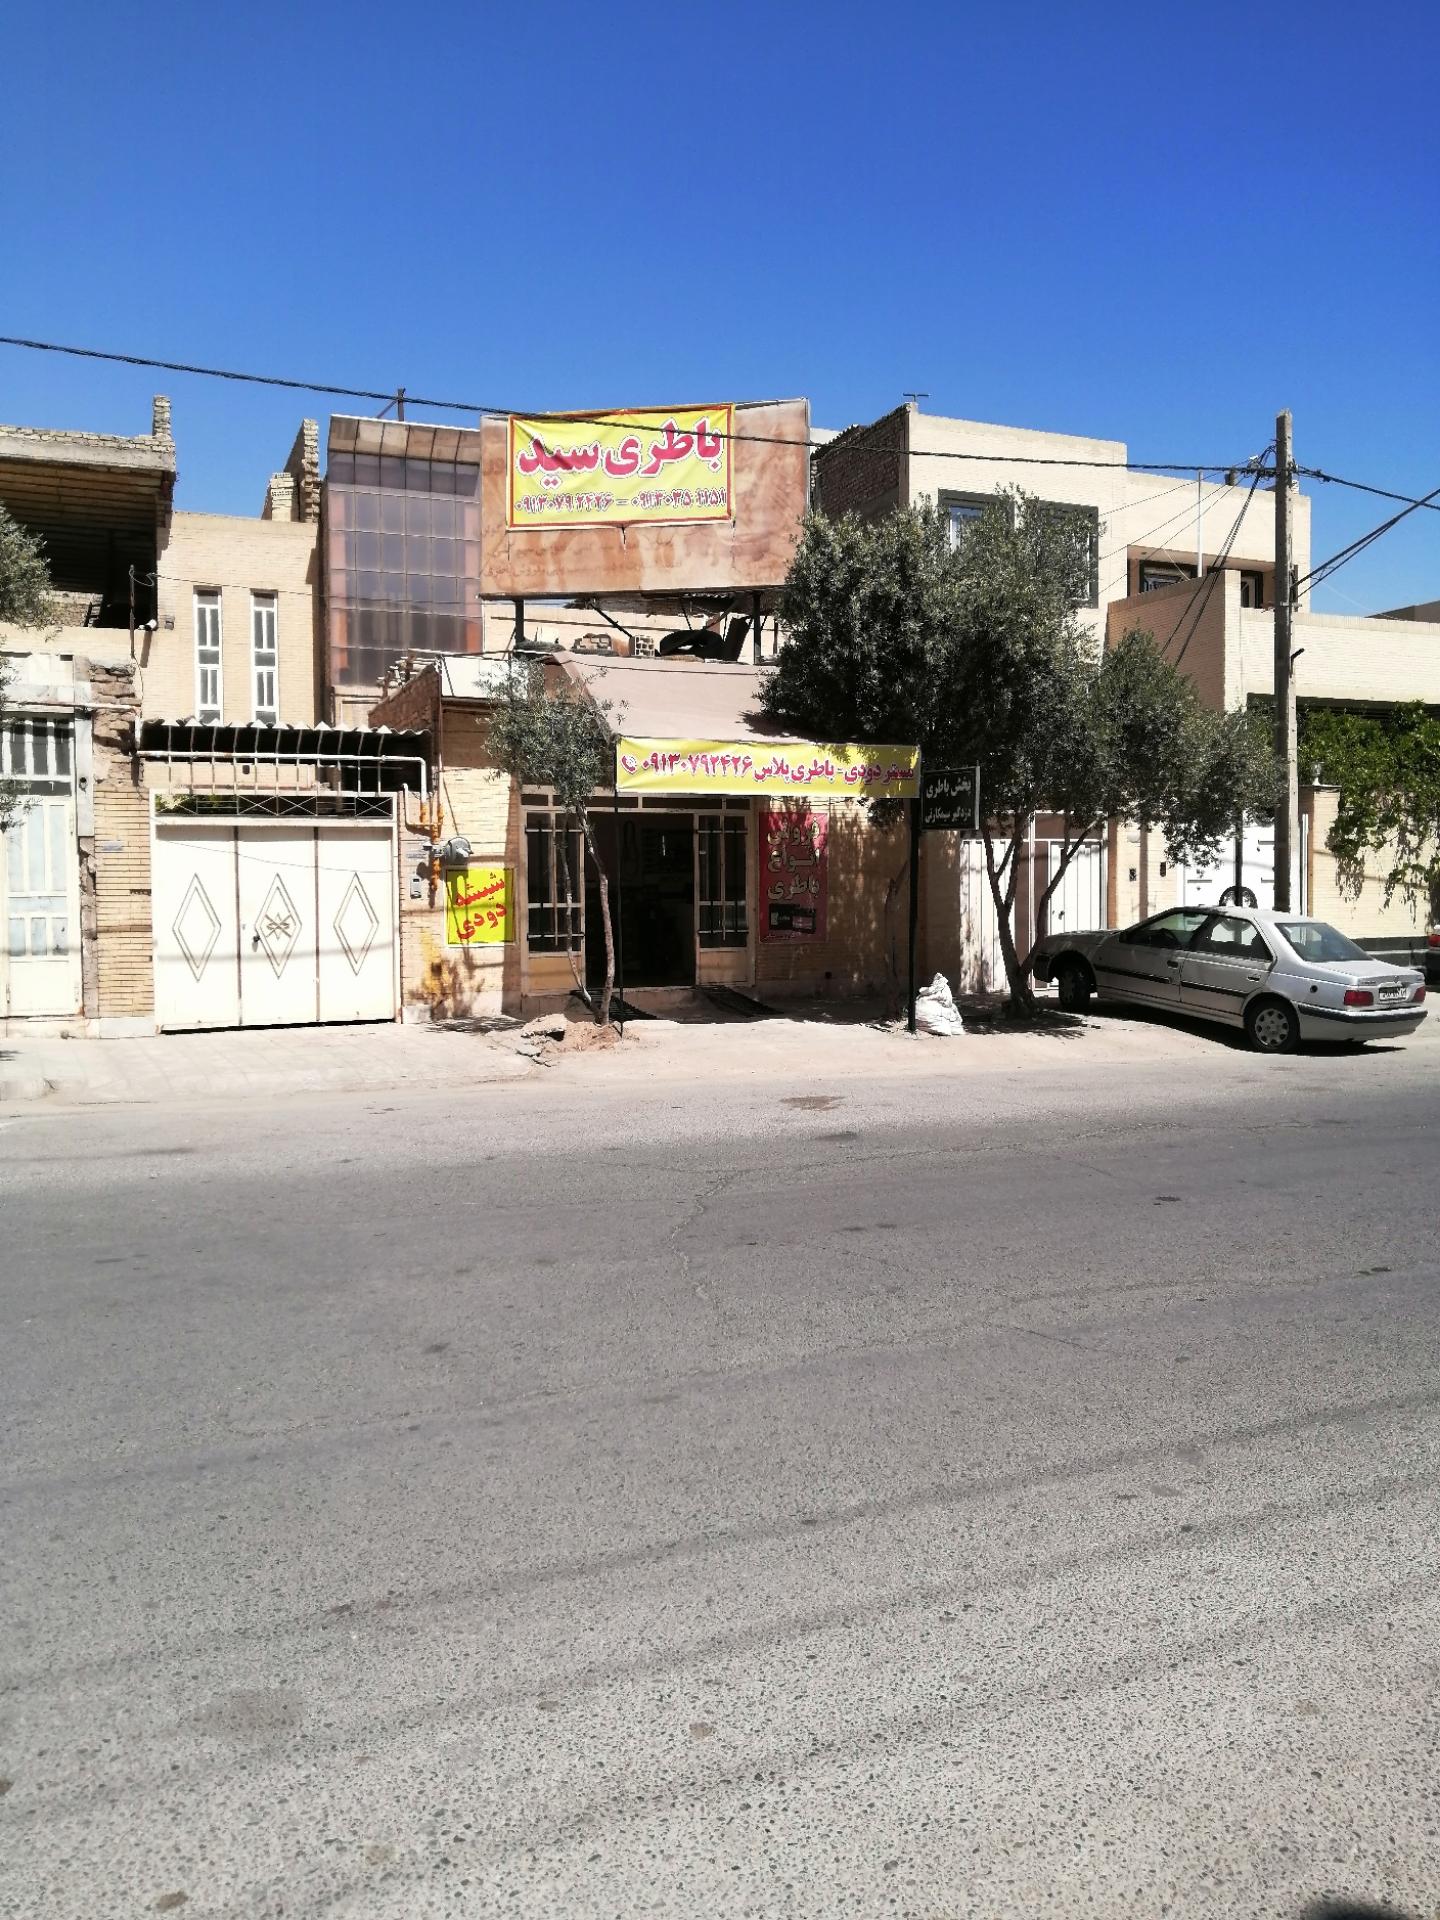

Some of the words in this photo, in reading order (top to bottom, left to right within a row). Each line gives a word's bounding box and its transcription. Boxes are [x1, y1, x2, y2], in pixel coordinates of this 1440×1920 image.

[604, 418, 722, 477] باطری
[519, 435, 600, 488] سید
[752, 756, 789, 782] پلاس
[791, 758, 835, 784] باطری
[926, 778, 950, 799] باطری
[951, 776, 971, 797] پخش
[456, 872, 505, 907] شیشه
[768, 873, 820, 900] باطری
[457, 903, 507, 939] دودی
